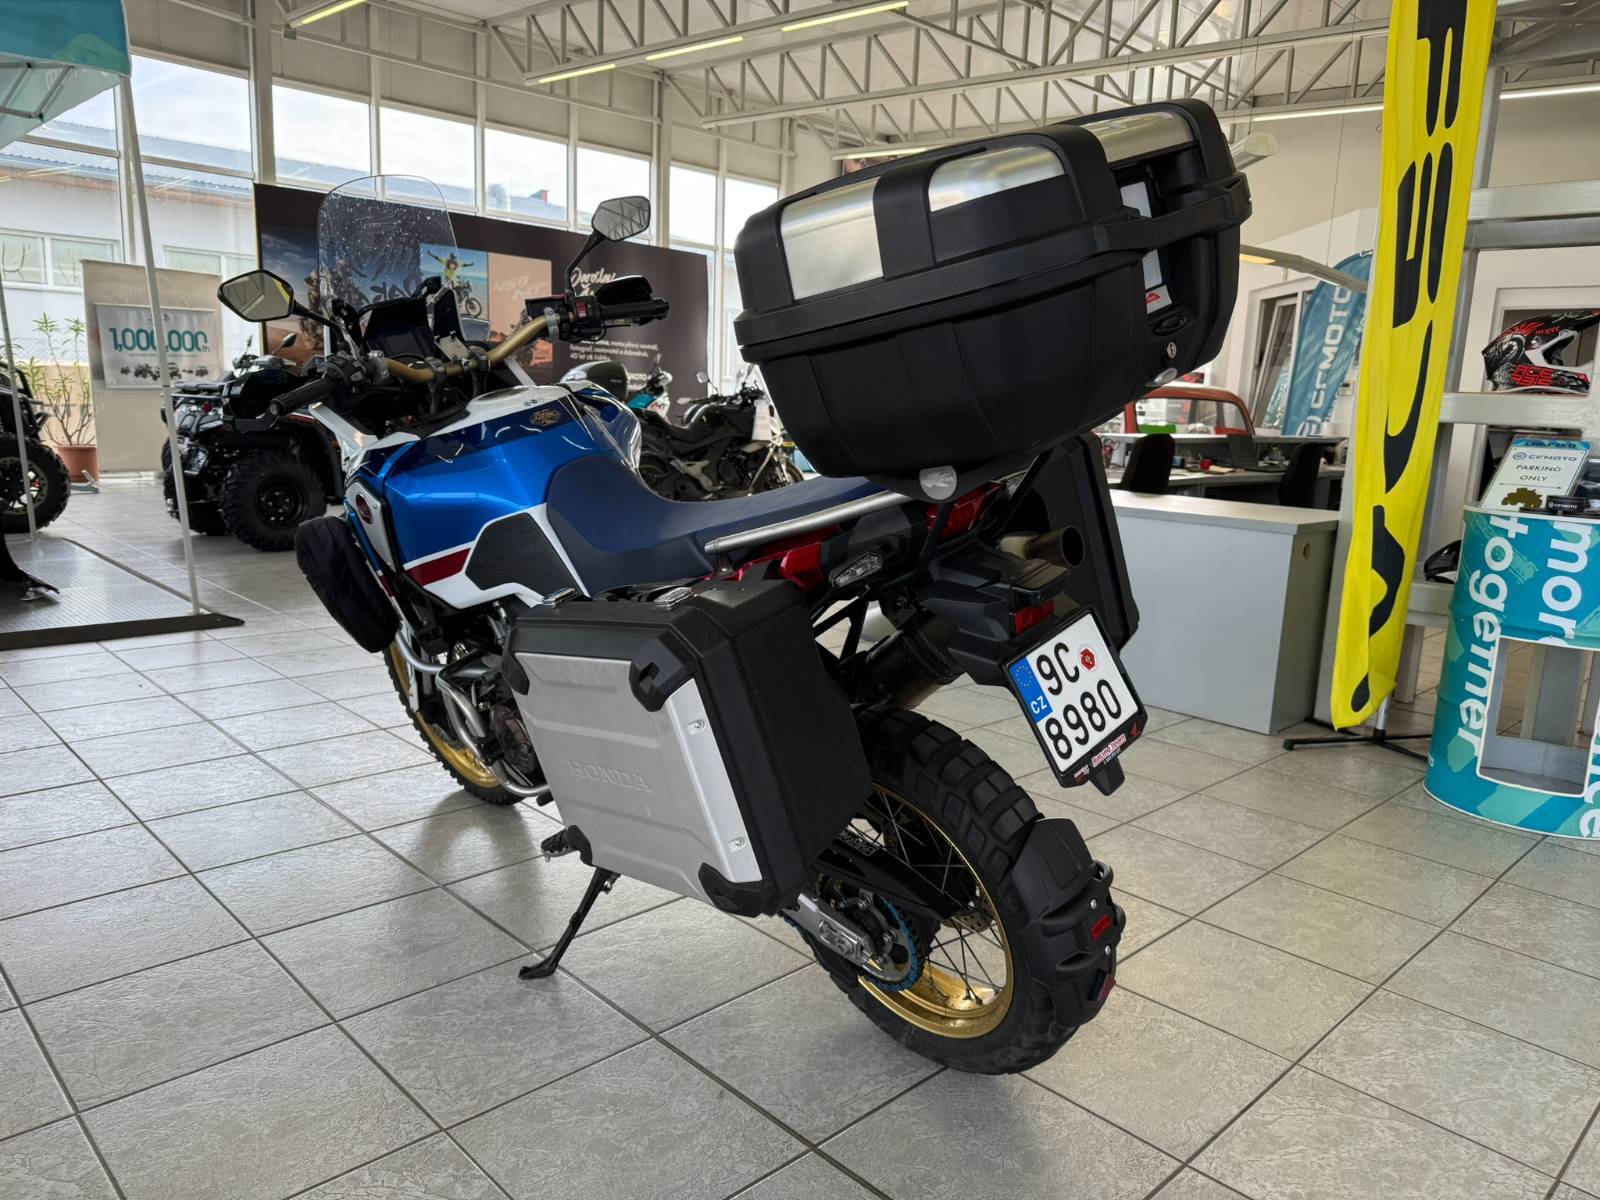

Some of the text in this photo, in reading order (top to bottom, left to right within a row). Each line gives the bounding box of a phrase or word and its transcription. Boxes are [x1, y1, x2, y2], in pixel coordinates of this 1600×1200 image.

[1310, 285, 1351, 409] CFMOTO
[1516, 464, 1562, 473] PARKING
[1528, 453, 1577, 462] CFMOTO
[1520, 474, 1549, 482] ONLY
[1036, 642, 1080, 696] 9C
[1030, 695, 1048, 715] CZ
[1045, 679, 1122, 760] 8980
[564, 760, 655, 794] HONDA
